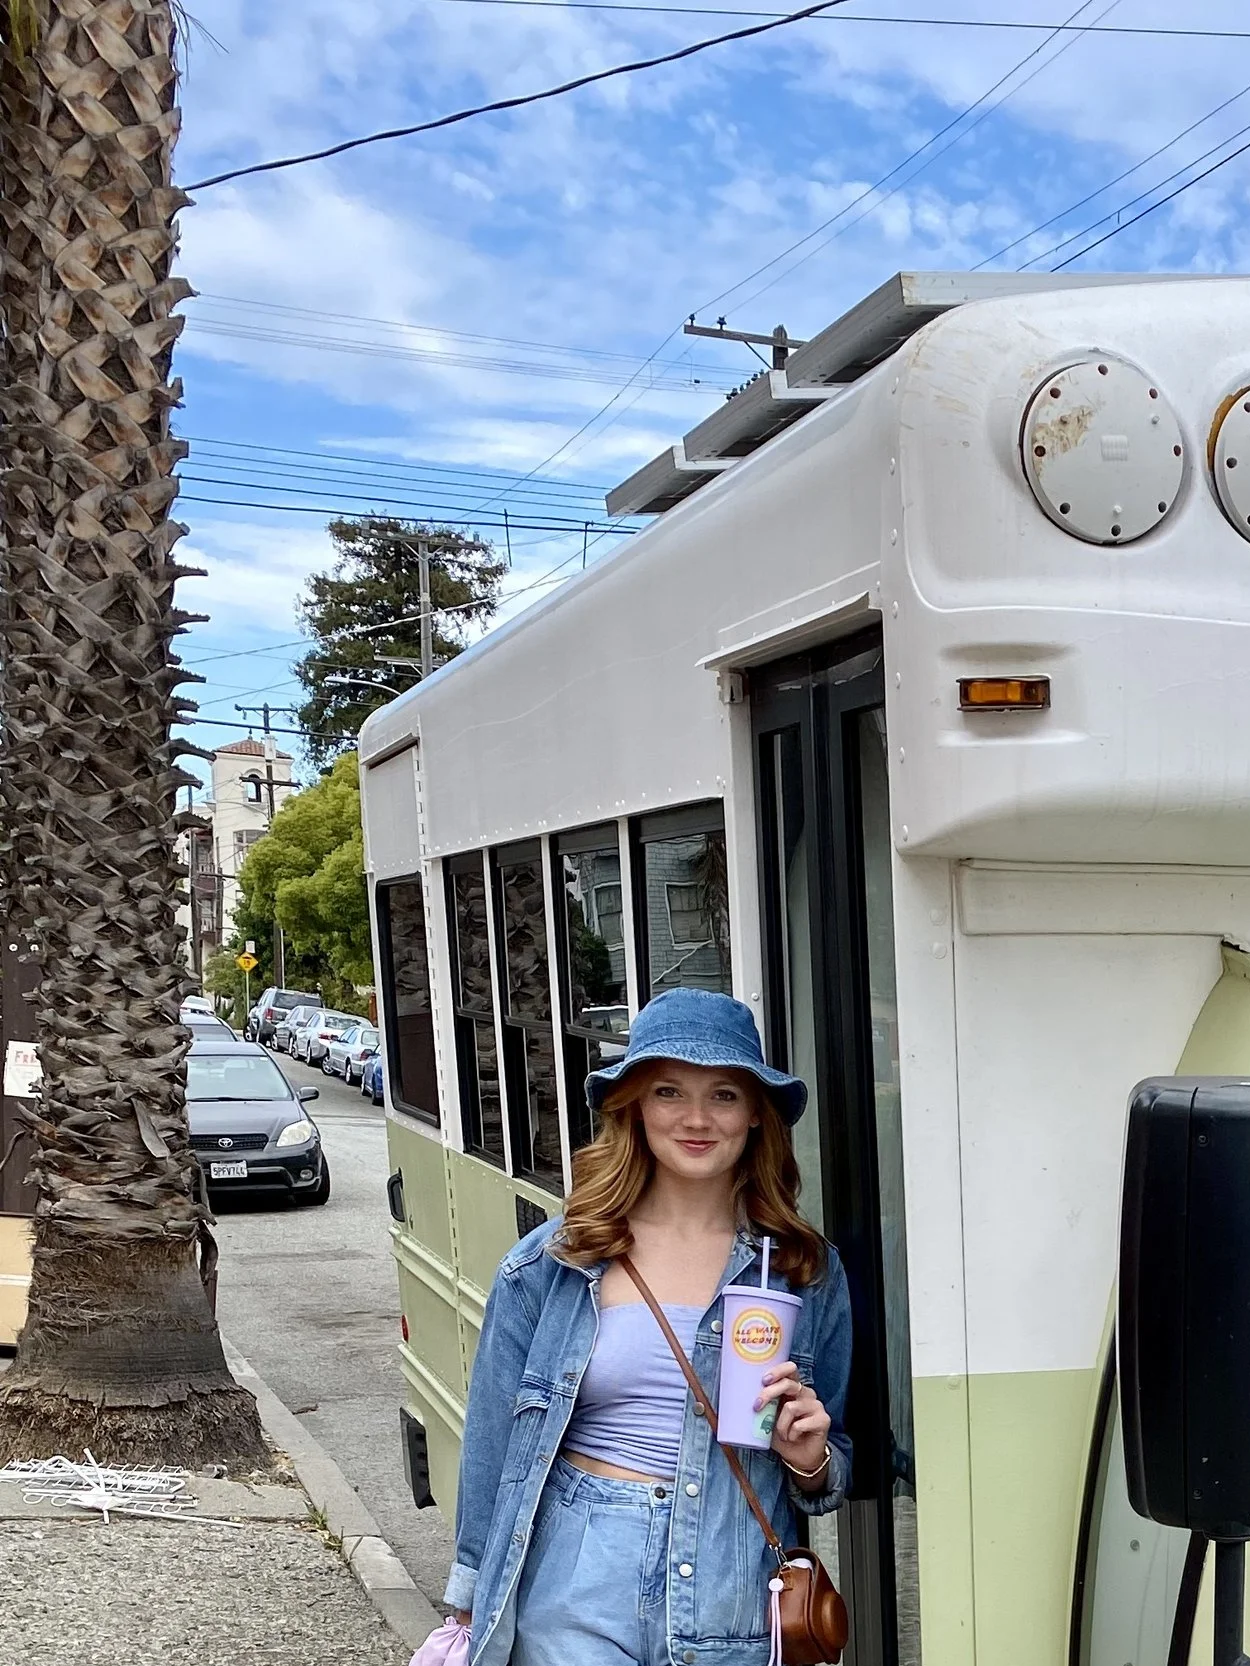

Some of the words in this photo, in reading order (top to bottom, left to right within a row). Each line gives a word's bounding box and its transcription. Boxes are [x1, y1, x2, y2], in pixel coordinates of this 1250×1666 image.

[15, 1050, 37, 1063] FRE
[755, 1327, 780, 1335] WAYS
[734, 1337, 778, 1345] WELCOME
